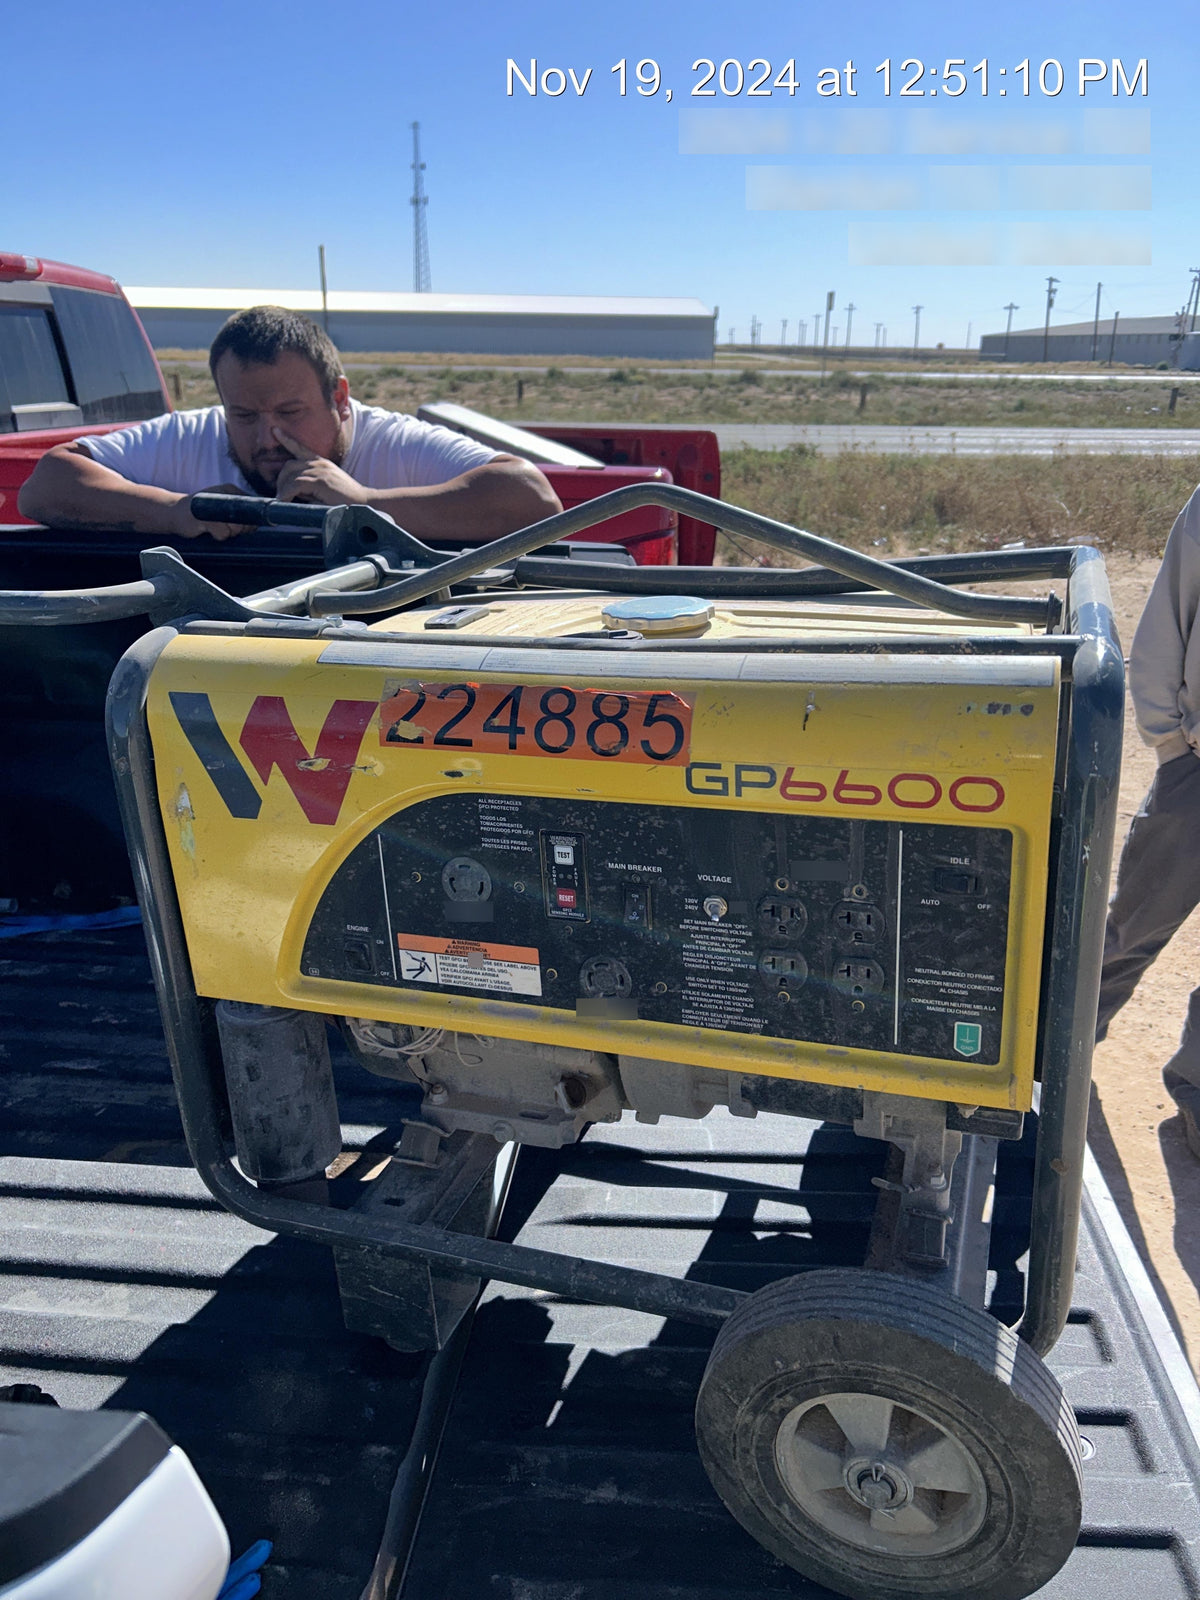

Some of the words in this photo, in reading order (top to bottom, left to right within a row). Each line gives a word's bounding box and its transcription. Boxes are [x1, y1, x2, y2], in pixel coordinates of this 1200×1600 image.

[386, 684, 685, 761] 224885
[685, 762, 1005, 813] GP6600
[698, 874, 732, 883] VOLTAGE
[907, 978, 942, 986] CONDUCTOR
[967, 984, 1002, 992] CONECTADO
[701, 991, 731, 999] SOLAMENTE
[690, 996, 723, 1005] INTERRUPTOR
[911, 998, 949, 1006] CONDUCTEUR
[682, 1014, 720, 1023] COMMUTATEUR
